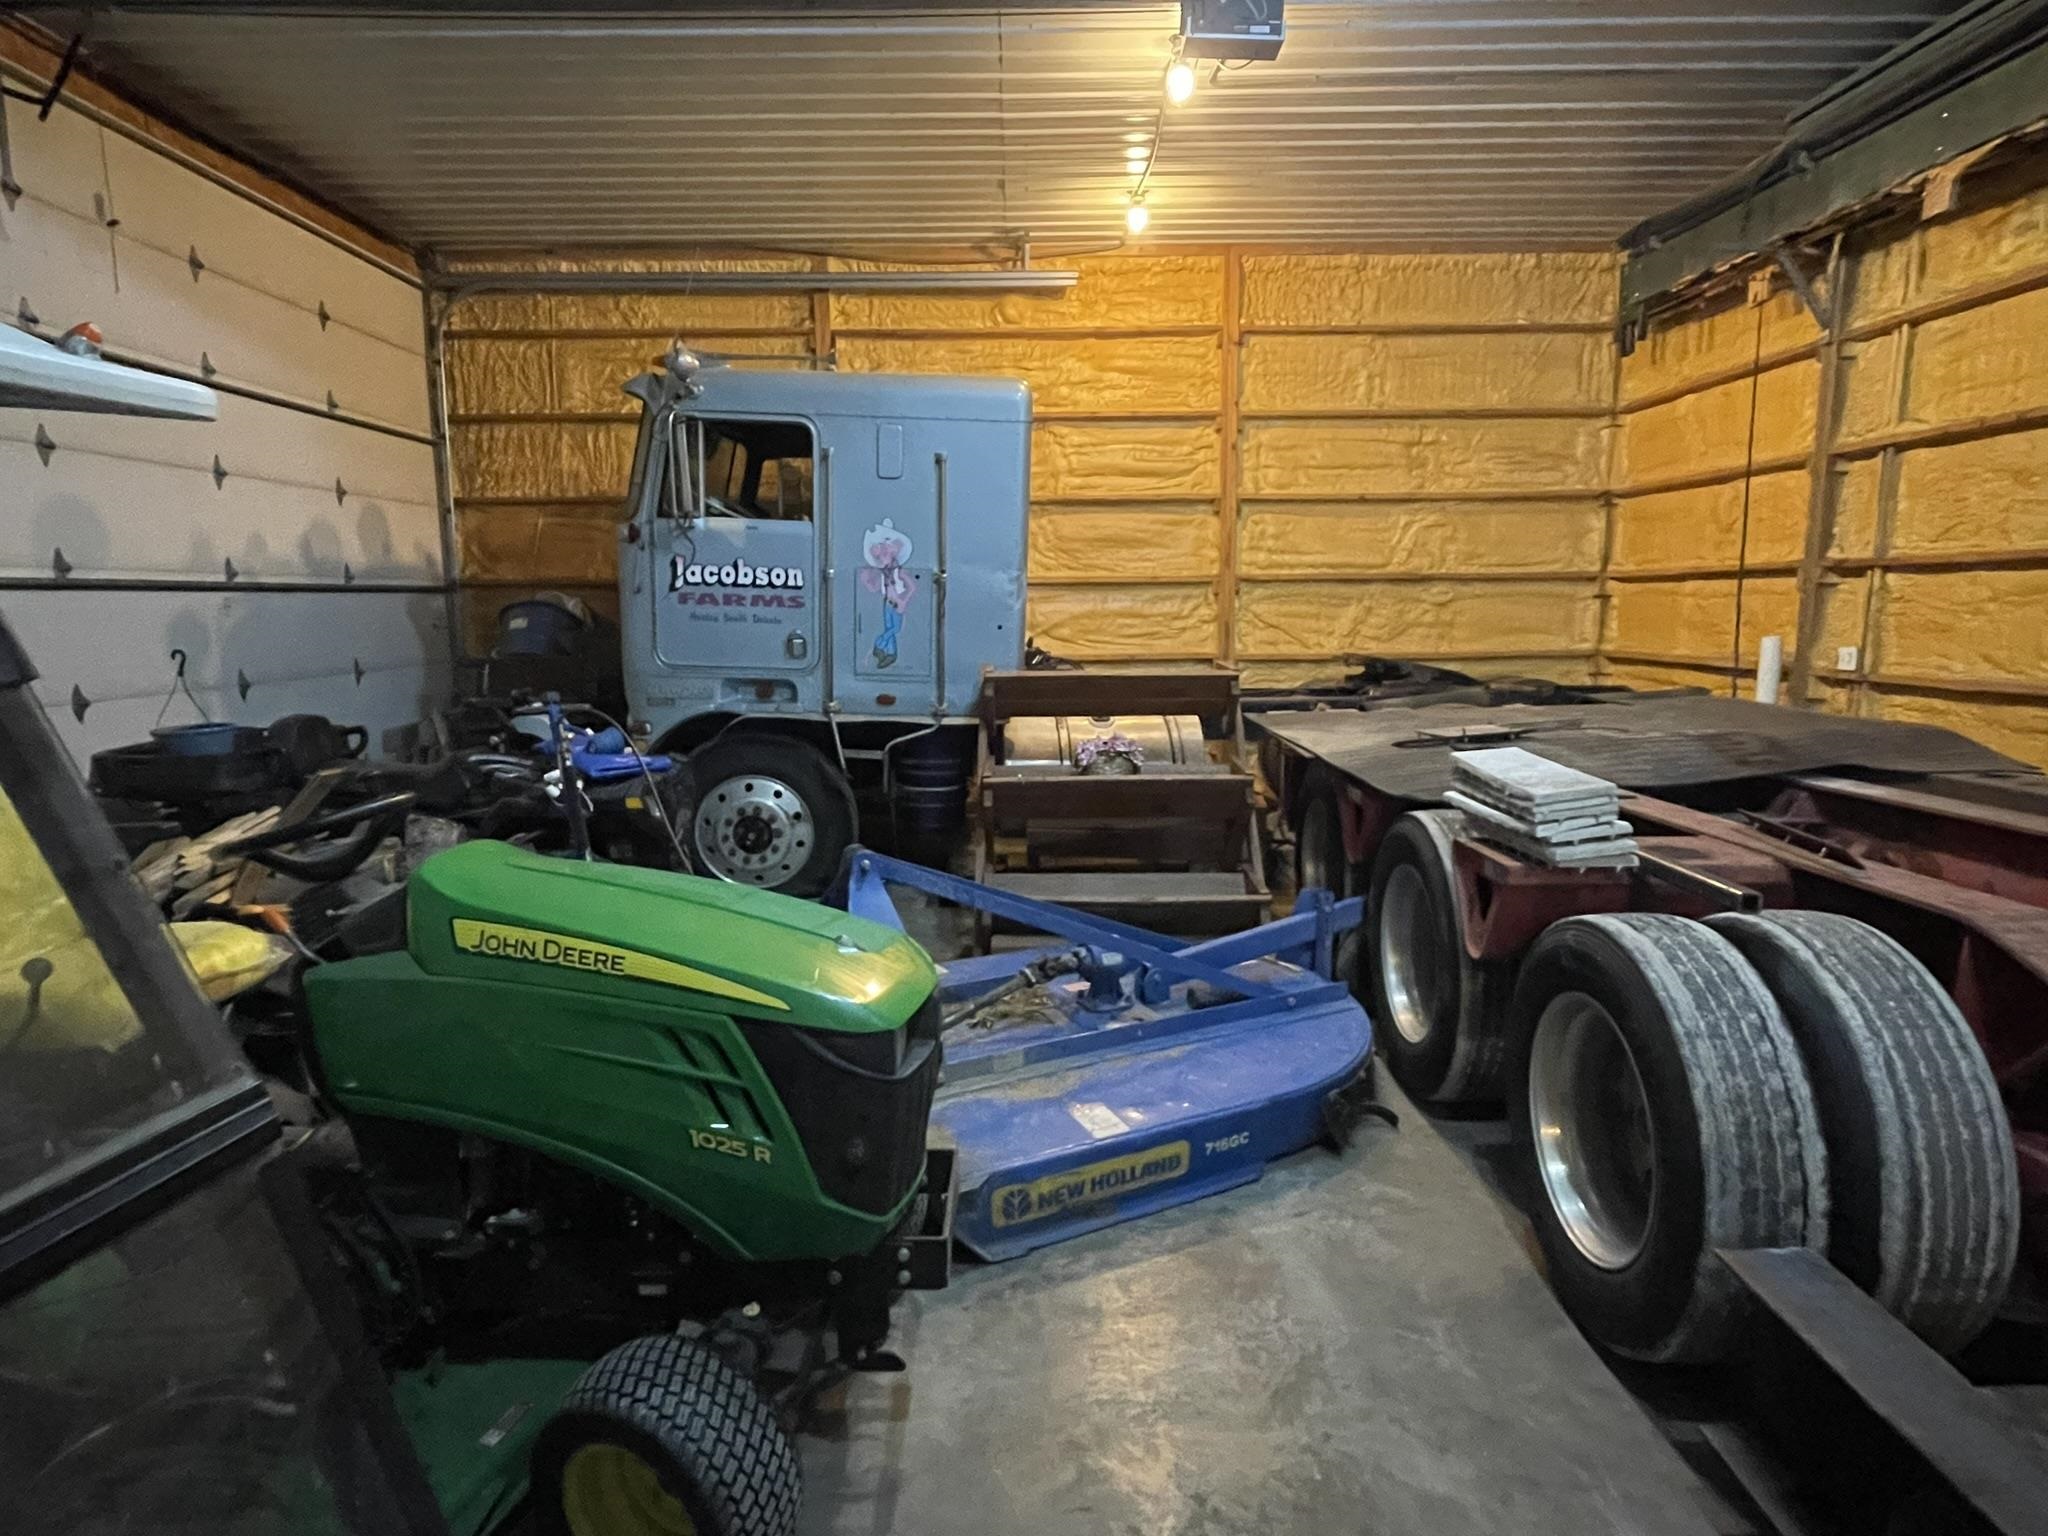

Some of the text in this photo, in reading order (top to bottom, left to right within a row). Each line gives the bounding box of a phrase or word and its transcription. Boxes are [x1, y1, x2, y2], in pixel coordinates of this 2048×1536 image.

[669, 555, 803, 591] Jacobson
[678, 592, 805, 608] FARMS
[470, 930, 626, 973] JOHN DEERE
[689, 1130, 771, 1163] 1025 R
[1037, 1154, 1181, 1209] NEW HOLLAND
